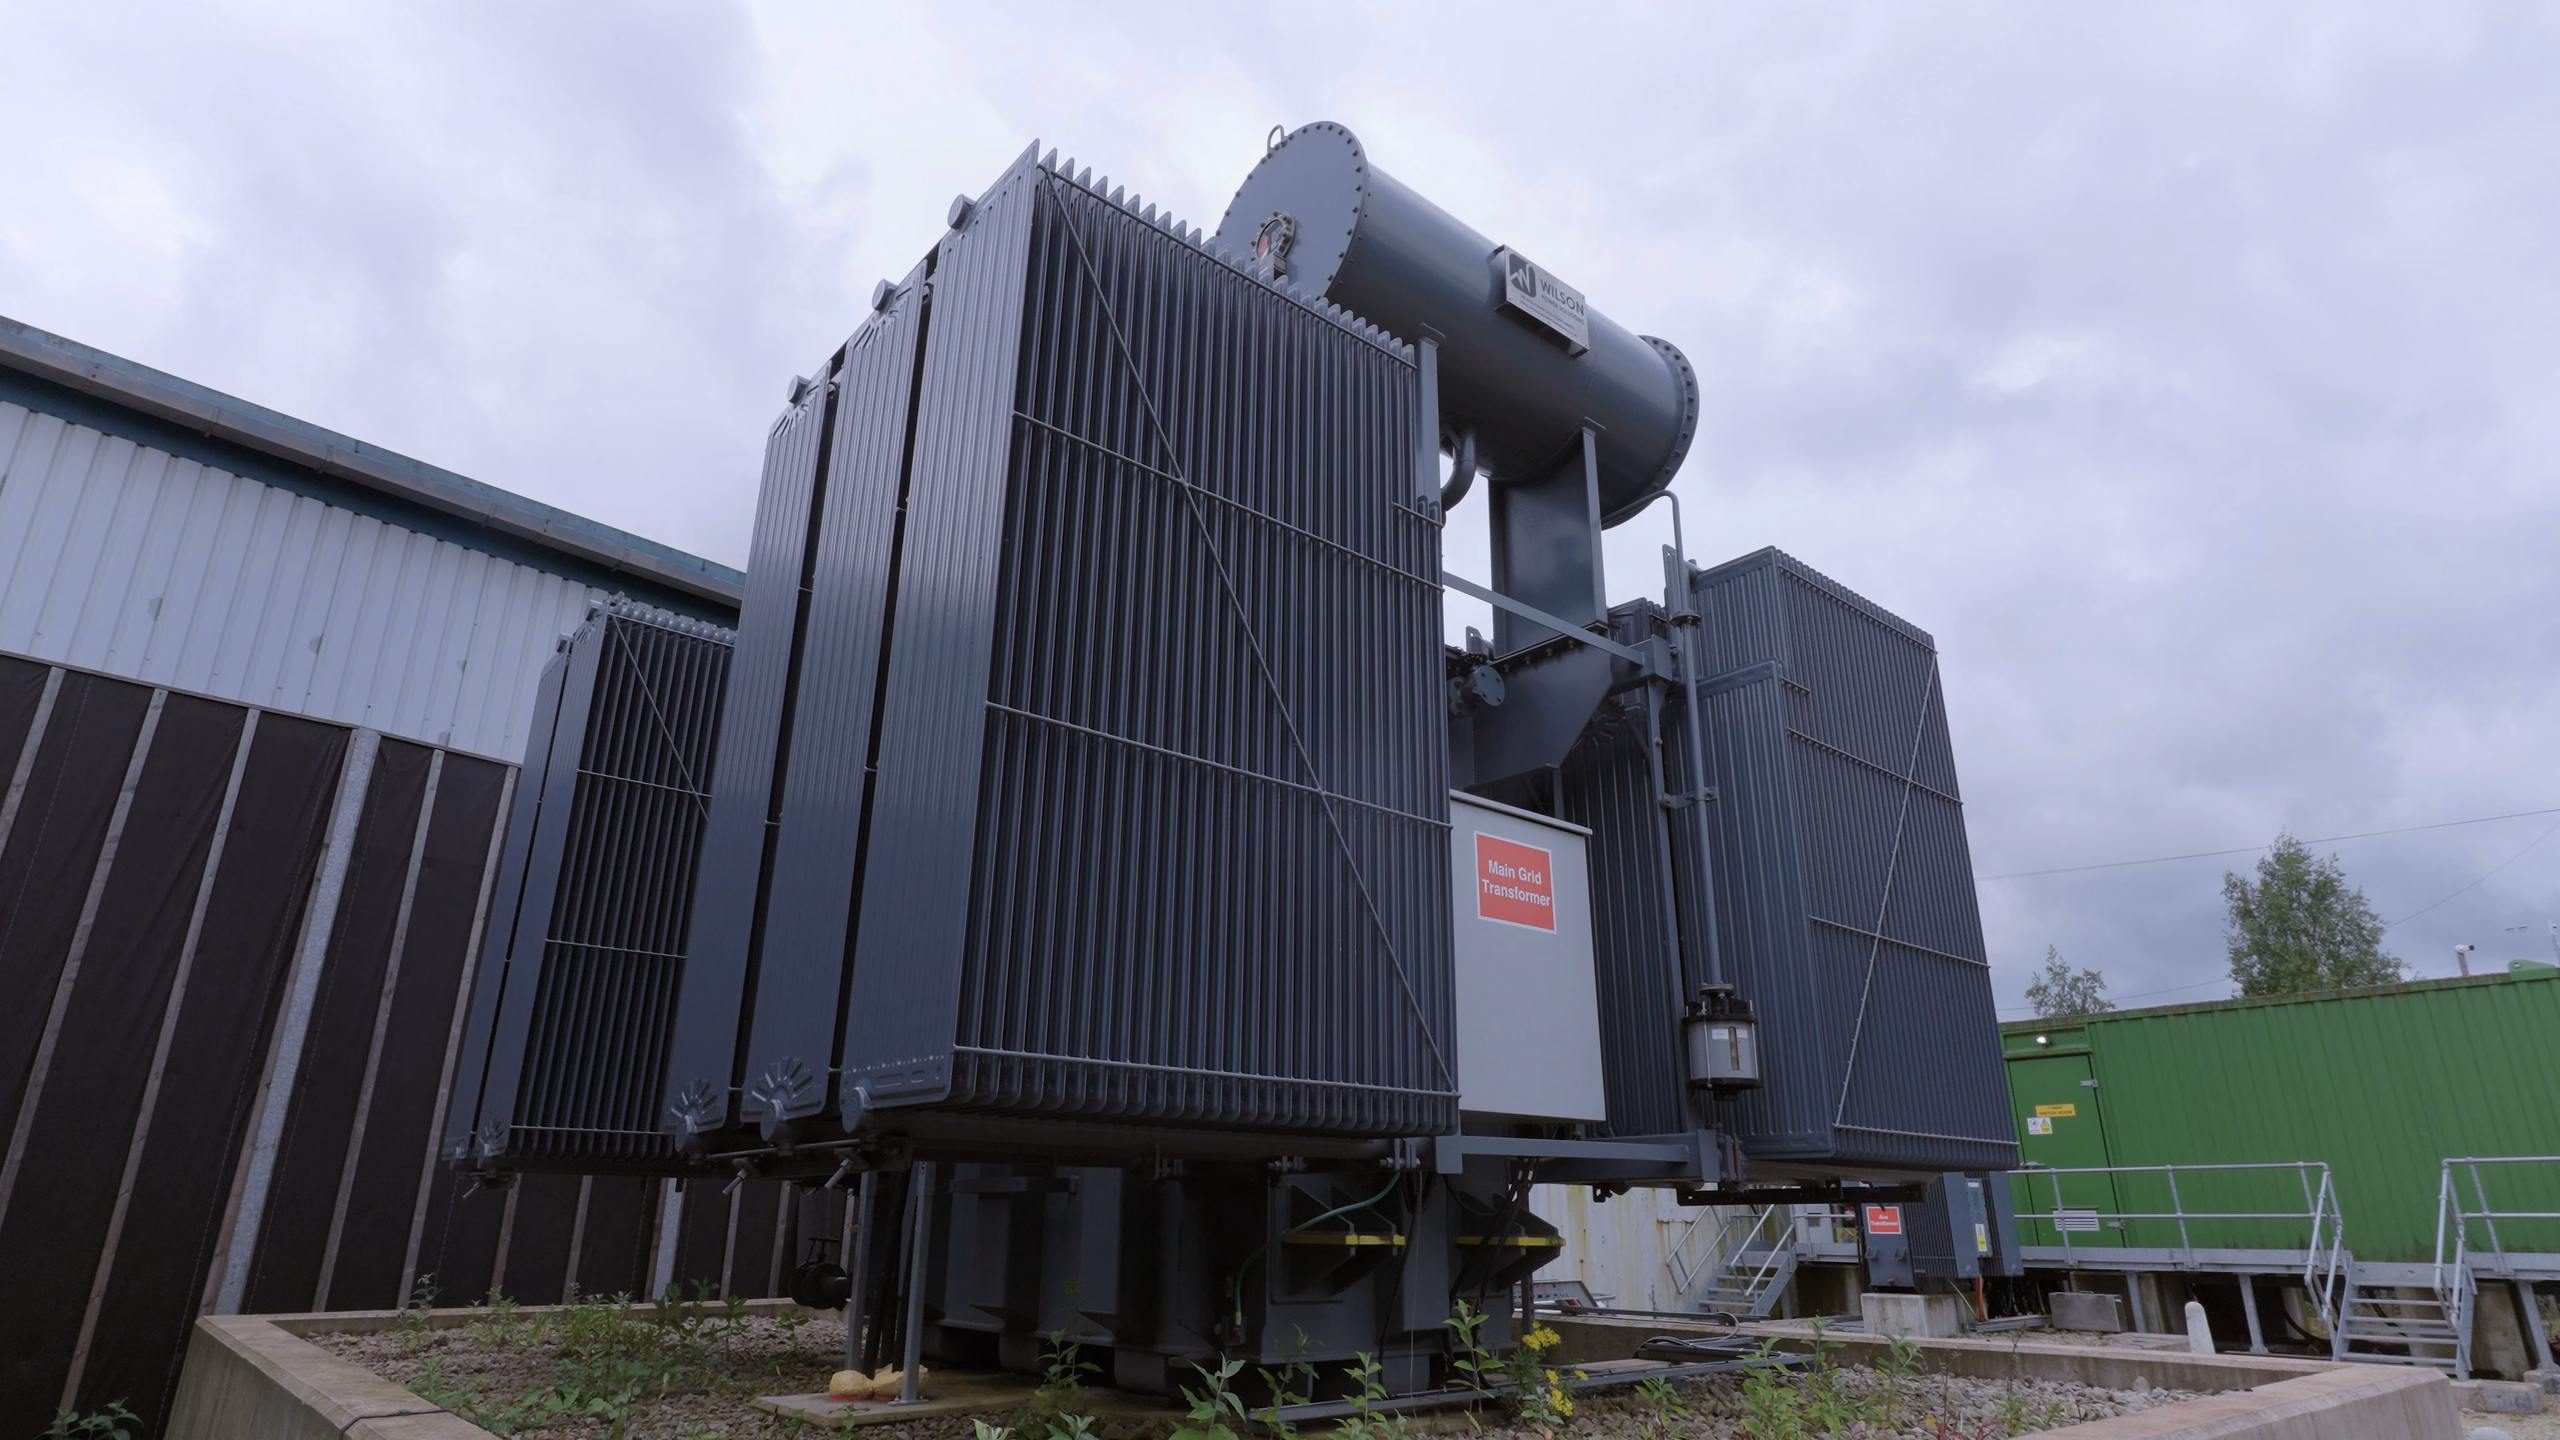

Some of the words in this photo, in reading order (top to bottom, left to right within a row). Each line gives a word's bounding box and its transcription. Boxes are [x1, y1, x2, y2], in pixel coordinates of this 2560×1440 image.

[1540, 279, 1584, 317] WILSON
[1541, 294, 1558, 309] POWER
[1559, 305, 1585, 325] SOLUTIONS
[1488, 860, 1516, 879] Main
[1518, 867, 1542, 885] Grid
[1481, 878, 1551, 907] Transformer
